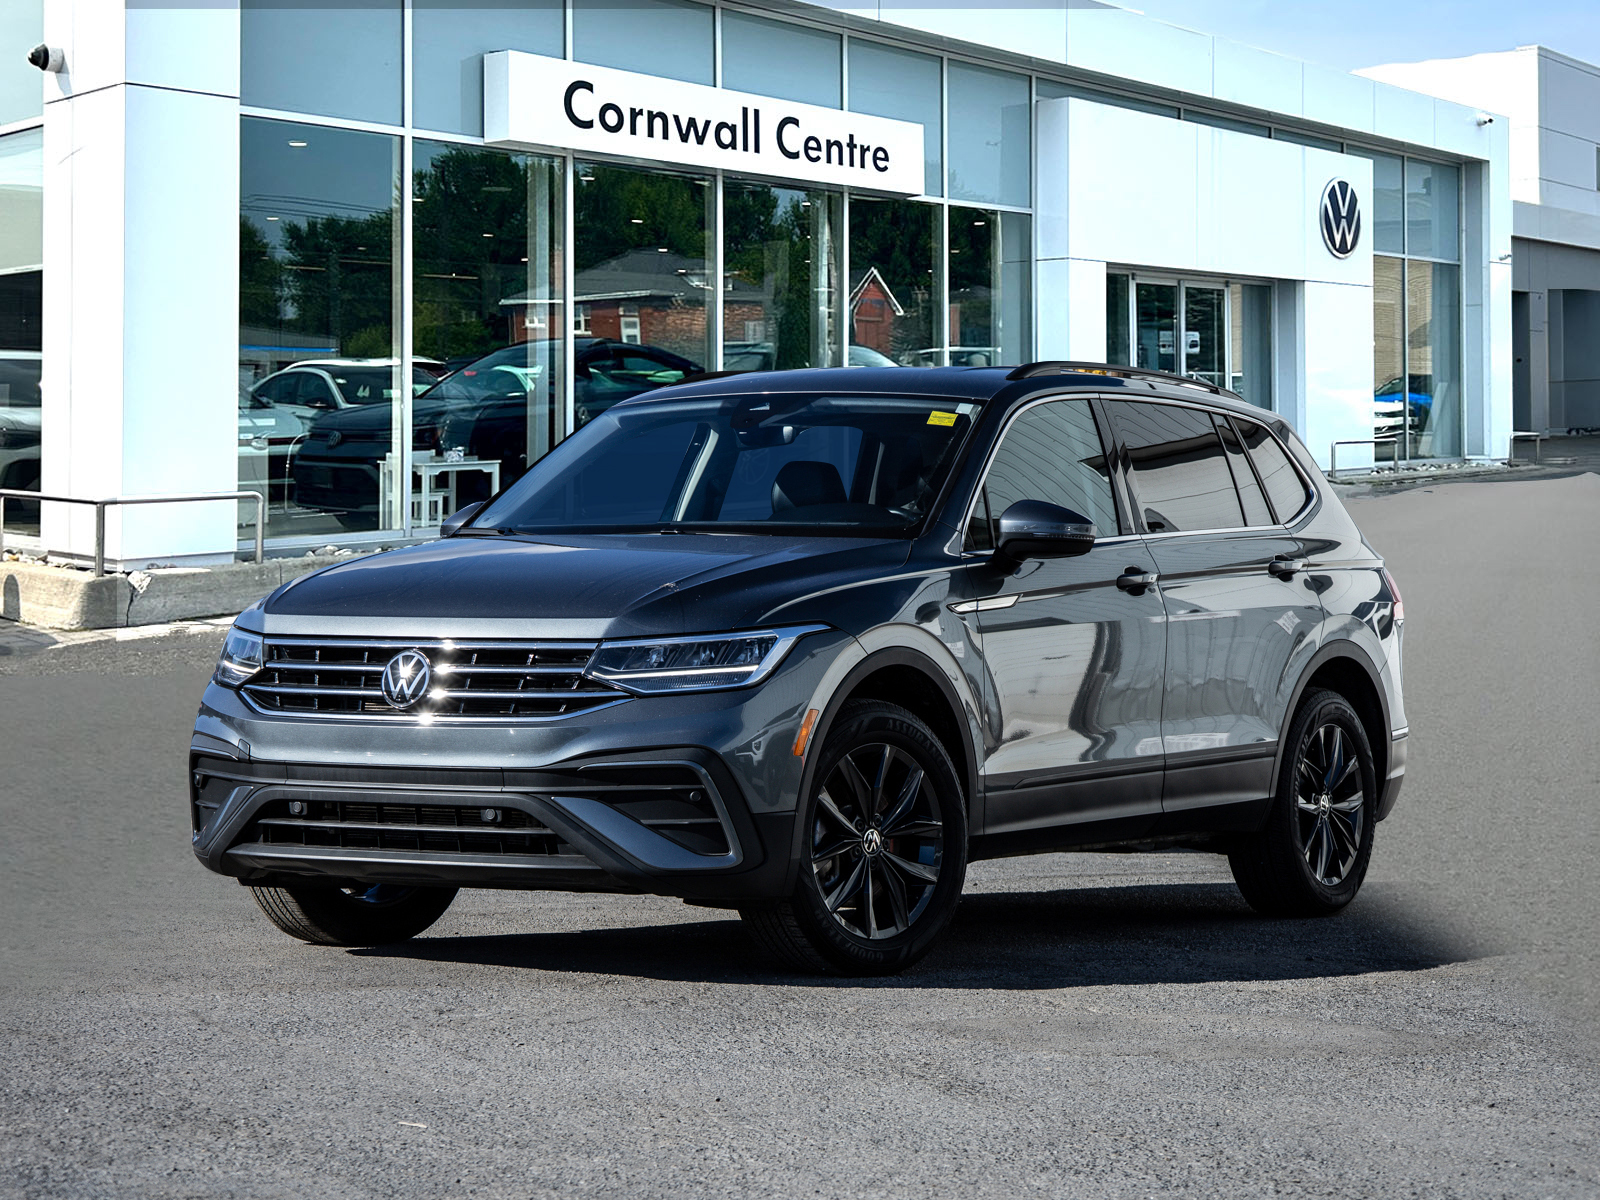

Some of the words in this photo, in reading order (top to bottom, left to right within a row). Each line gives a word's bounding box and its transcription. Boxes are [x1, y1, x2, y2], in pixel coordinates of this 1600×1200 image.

[563, 80, 761, 154] Cornwall
[776, 116, 890, 173] Centre
[1320, 178, 1361, 258] VW
[383, 651, 430, 708] VW
